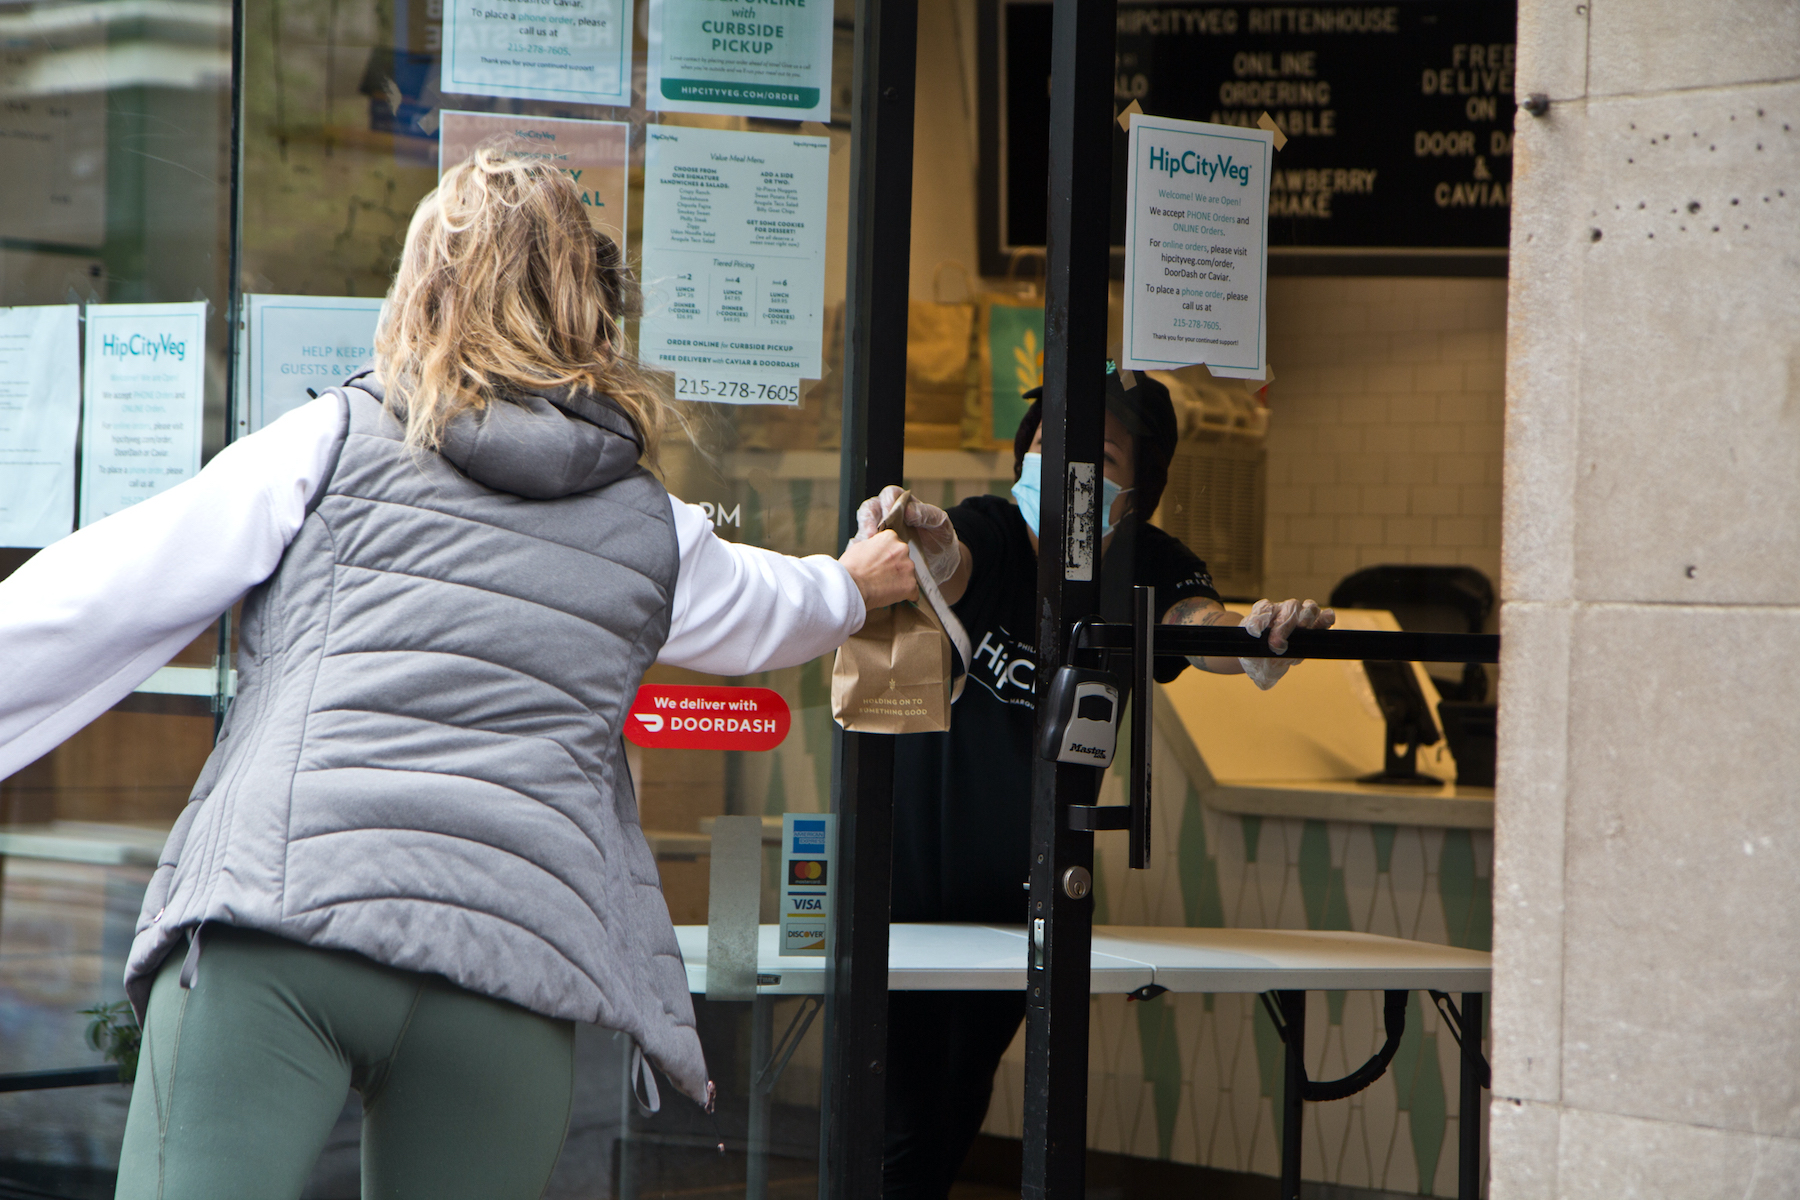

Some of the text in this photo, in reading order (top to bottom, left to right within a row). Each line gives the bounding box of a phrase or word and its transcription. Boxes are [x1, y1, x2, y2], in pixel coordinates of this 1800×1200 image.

[471, 8, 482, 17] To
[485, 9, 508, 20] place
[518, 12, 546, 22] phone
[549, 15, 576, 26] order,
[578, 17, 607, 28] please
[732, 6, 756, 19] with
[1247, 7, 1399, 33] RITTENHOUSE
[519, 26, 534, 36] call
[549, 29, 558, 37] at
[702, 20, 784, 38] CURBSIDE
[508, 42, 571, 56] 215-278-7605.
[712, 38, 774, 54] PICKUP
[480, 56, 498, 64] Thank
[537, 62, 568, 70] continued
[1452, 43, 1515, 69] FREE
[1232, 51, 1317, 77] ONLINE
[1421, 69, 1514, 95] DELIVE
[681, 86, 800, 101] HIPCITYVEG.COM/ORDER
[1219, 80, 1331, 106] ORDERING
[1465, 96, 1497, 121] ON
[1414, 130, 1475, 156] DOOR
[710, 153, 765, 164] Value Meal Menu
[1149, 146, 1250, 187] HipCityVeg
[660, 178, 698, 186] SANDWICHES
[1271, 168, 1378, 194] AWBERRY
[1158, 189, 1194, 201] Welcome!
[1195, 193, 1207, 203] We
[1221, 196, 1242, 206] Open!
[1269, 193, 1333, 218] HAKE
[1149, 206, 1250, 225] We accept PHONE Orders and
[1173, 223, 1226, 236] ONLINE Orders.
[1149, 238, 1248, 256] For online orders, please visit
[713, 258, 755, 270] Tiered Pricing
[1161, 253, 1235, 270] hipcityveg.com/order,
[1164, 268, 1231, 282] DoorDash or Caviar.
[1146, 284, 1155, 292] To
[1156, 285, 1174, 295] place
[1181, 287, 1204, 298] phone
[1204, 290, 1226, 300] order,
[1226, 291, 1249, 302] please
[1182, 301, 1194, 310] call
[1204, 304, 1212, 312] at
[1173, 318, 1222, 331] 215-278-7605.
[666, 338, 794, 352] ORDER ONLINE for CURBSIDE PICKUP
[1152, 332, 1167, 340] Thank
[1196, 336, 1219, 344] continued
[1219, 339, 1239, 347] support!
[102, 333, 185, 362] HipCityVeg
[302, 346, 333, 358] HELP
[336, 347, 366, 358] KEEP
[659, 354, 676, 362] FREE
[678, 355, 712, 363] DELIVERY
[725, 358, 751, 366] CAVIAR
[759, 360, 800, 368] DOORDASH
[281, 363, 328, 375] GUESTS
[332, 364, 341, 376] &
[678, 378, 798, 402] 215-278-7605
[1017, 642, 1036, 654] PHIL
[654, 696, 758, 711] We deliver with
[863, 698, 898, 706] HOLDING
[899, 698, 911, 706] ON
[1010, 698, 1035, 710] MARQU
[858, 707, 928, 716] SOMETHING GOOD
[670, 716, 776, 734] DOORDASH
[1070, 742, 1106, 754] Master
[792, 898, 822, 910] VISA
[788, 930, 824, 938] DISCOVER
